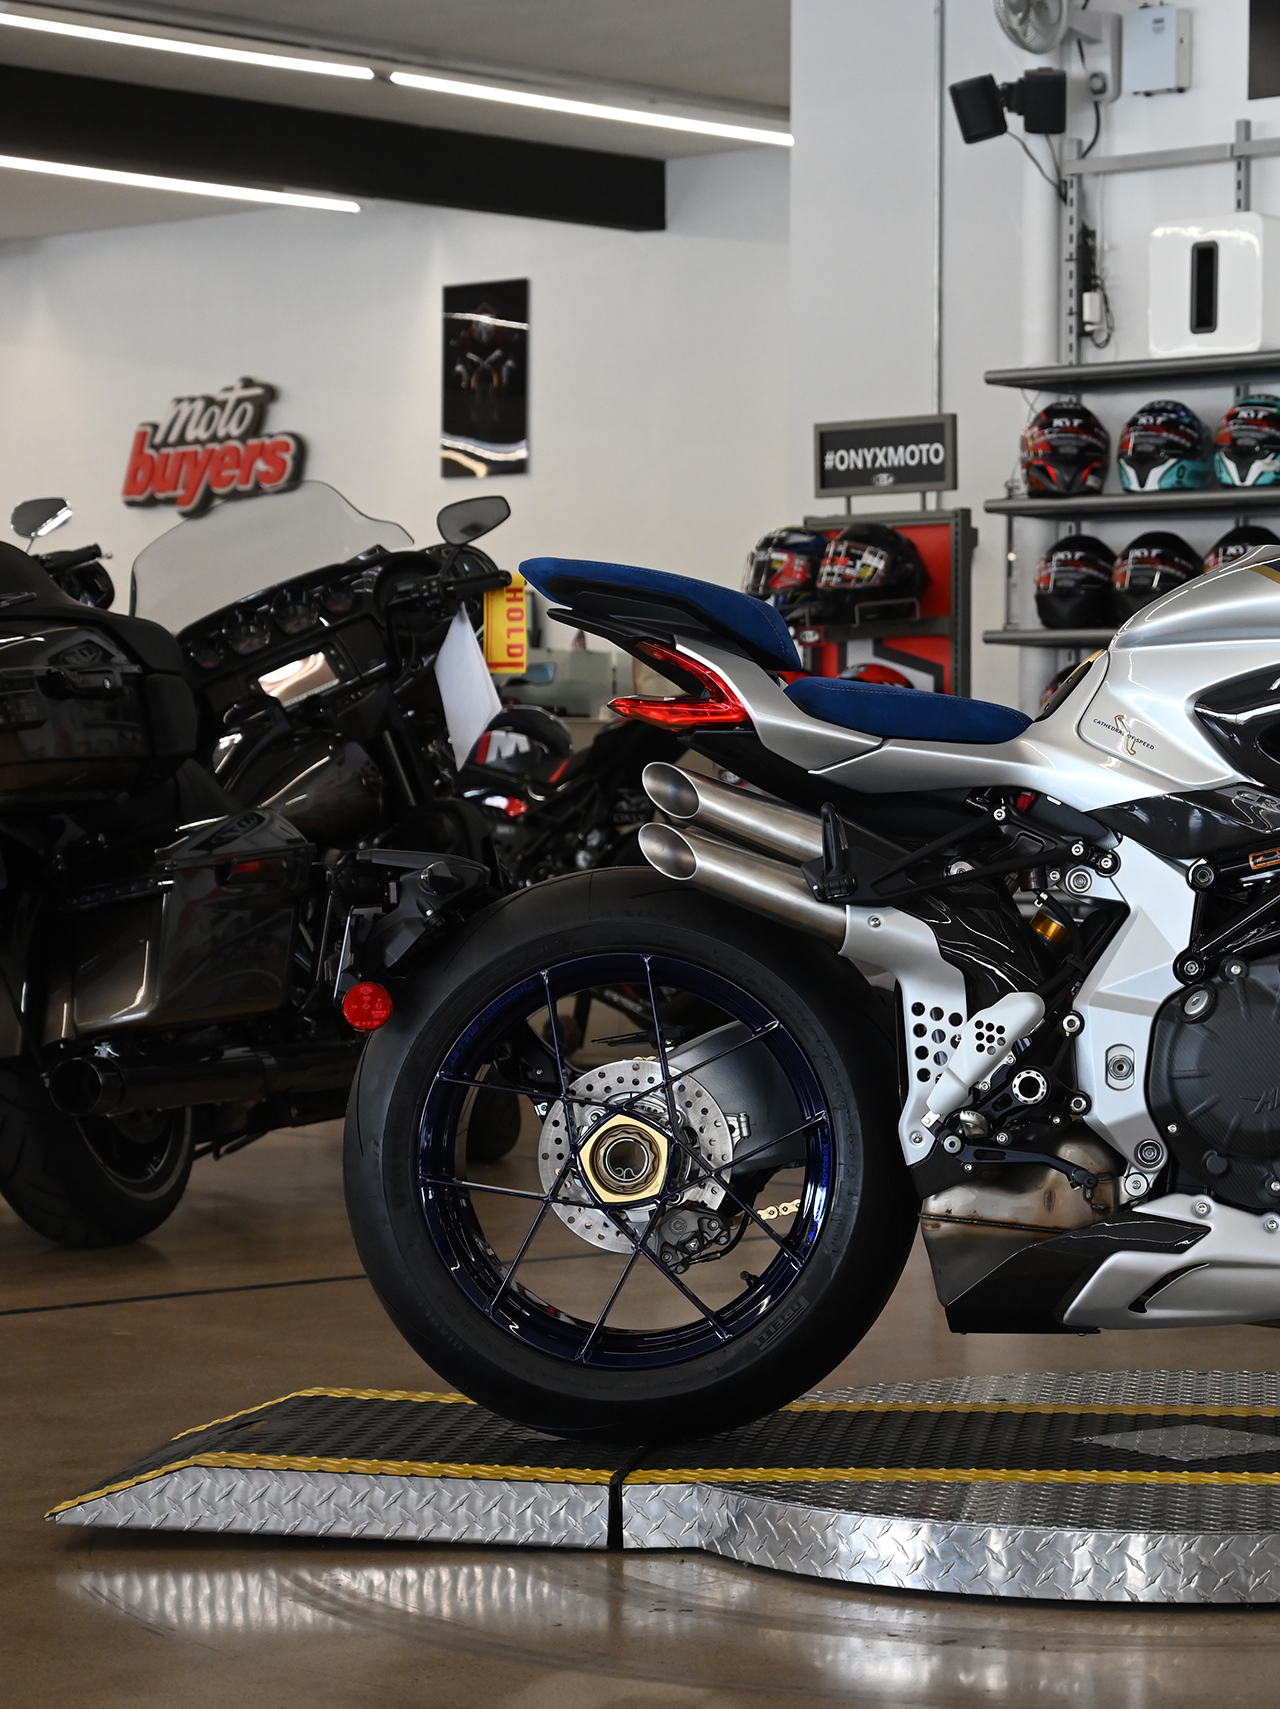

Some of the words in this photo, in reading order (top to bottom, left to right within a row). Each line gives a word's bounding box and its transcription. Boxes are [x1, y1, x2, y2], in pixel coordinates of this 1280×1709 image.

[122, 430, 291, 507] buyers
[824, 442, 945, 471] #ONYXMOTO
[1135, 738, 1155, 750] SPEED
